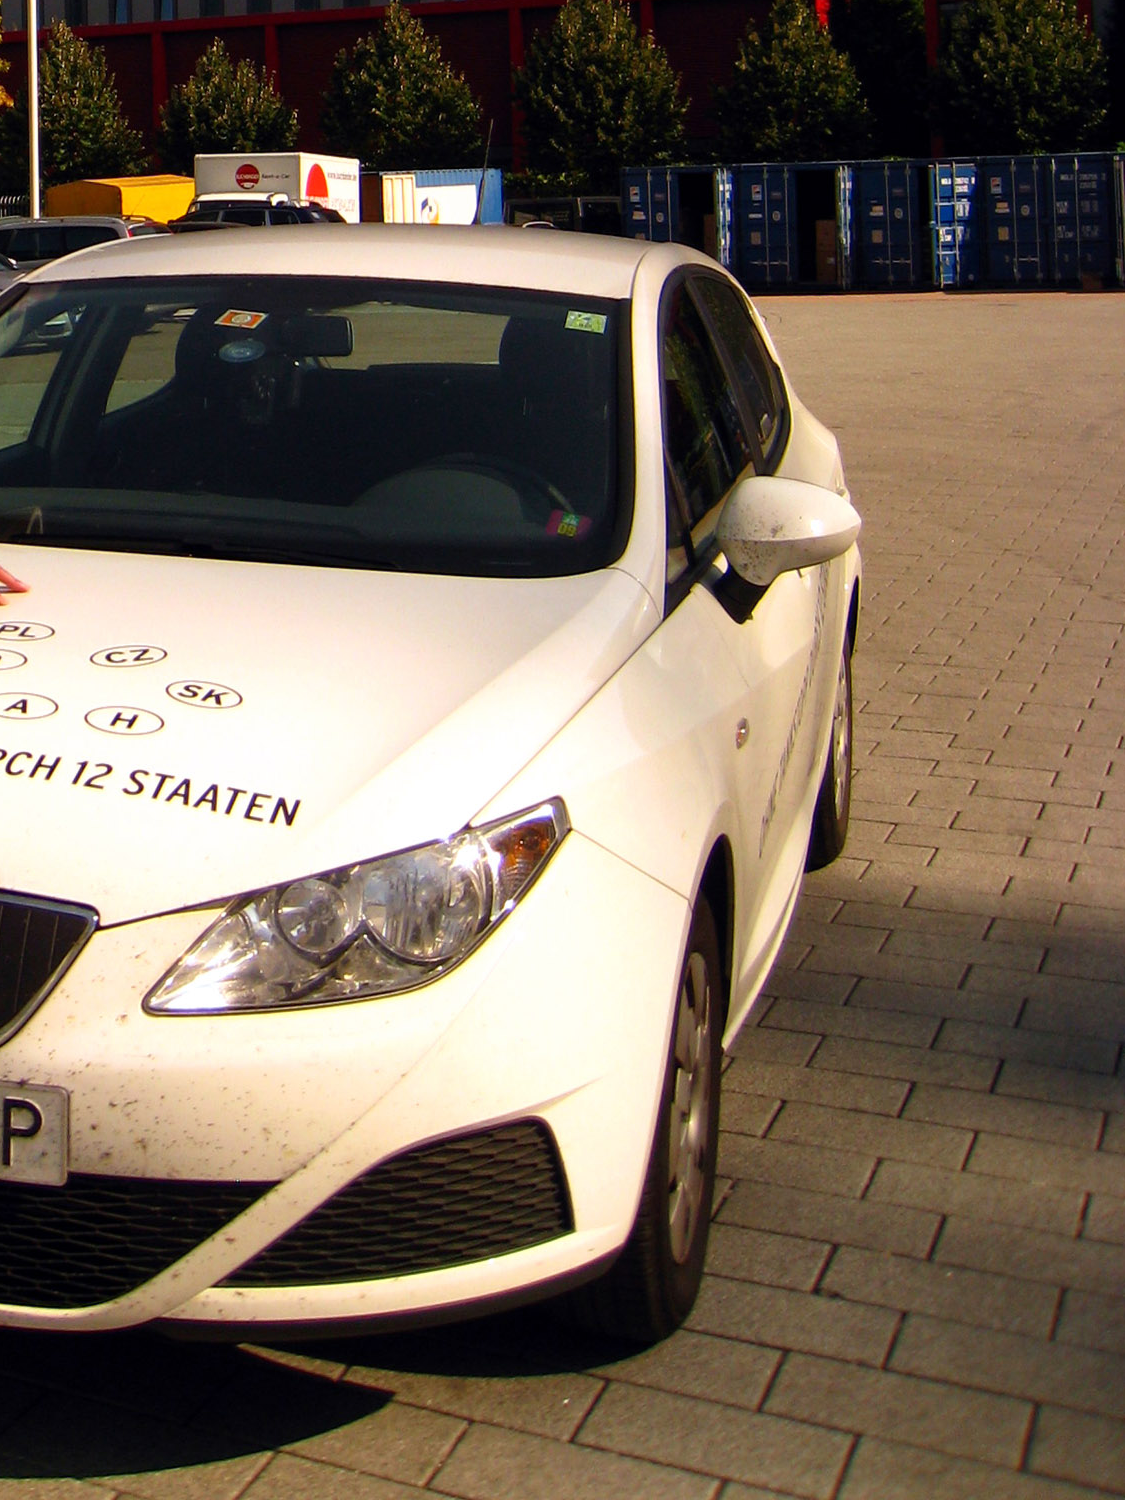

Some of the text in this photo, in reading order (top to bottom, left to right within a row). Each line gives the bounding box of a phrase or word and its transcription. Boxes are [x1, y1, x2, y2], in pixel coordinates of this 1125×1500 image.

[105, 649, 154, 663] CZ
[177, 684, 230, 706] SK
[4, 699, 28, 714] A
[110, 712, 139, 729] H
[71, 760, 114, 790] 12
[122, 769, 302, 827] STAATEN
